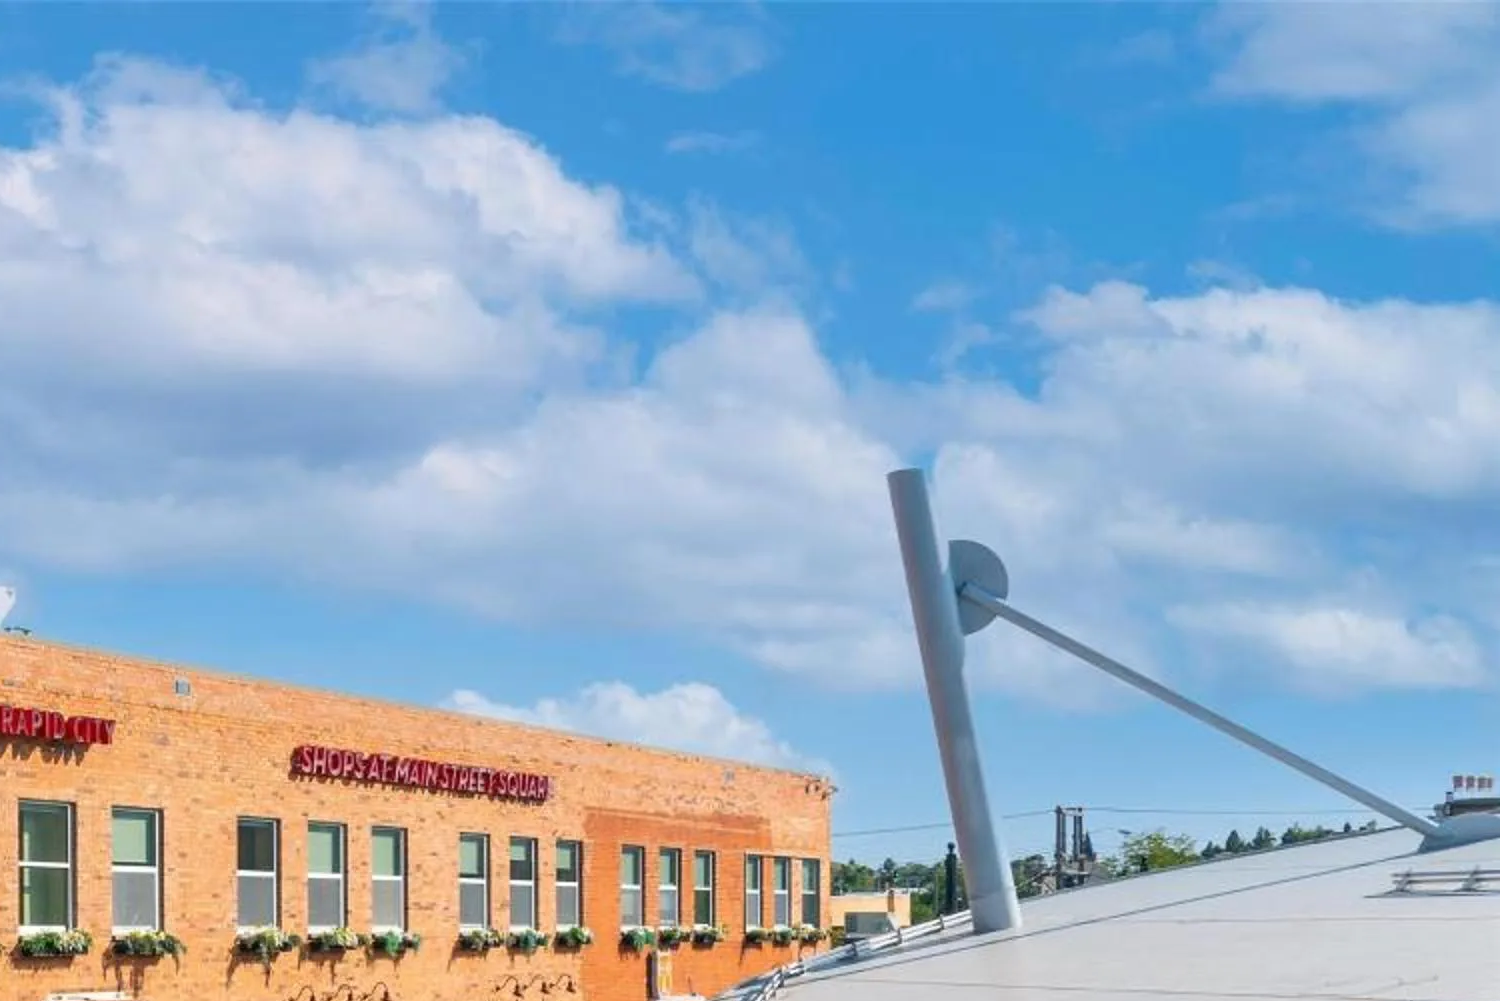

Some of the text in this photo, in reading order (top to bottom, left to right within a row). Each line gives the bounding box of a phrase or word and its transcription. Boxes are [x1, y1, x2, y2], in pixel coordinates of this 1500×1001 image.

[1, 706, 66, 740] RAPID
[72, 716, 116, 744] CITY
[301, 746, 365, 779] SHOPS
[368, 753, 391, 781] AT
[395, 759, 438, 788] MAIN
[441, 764, 495, 793] STREET
